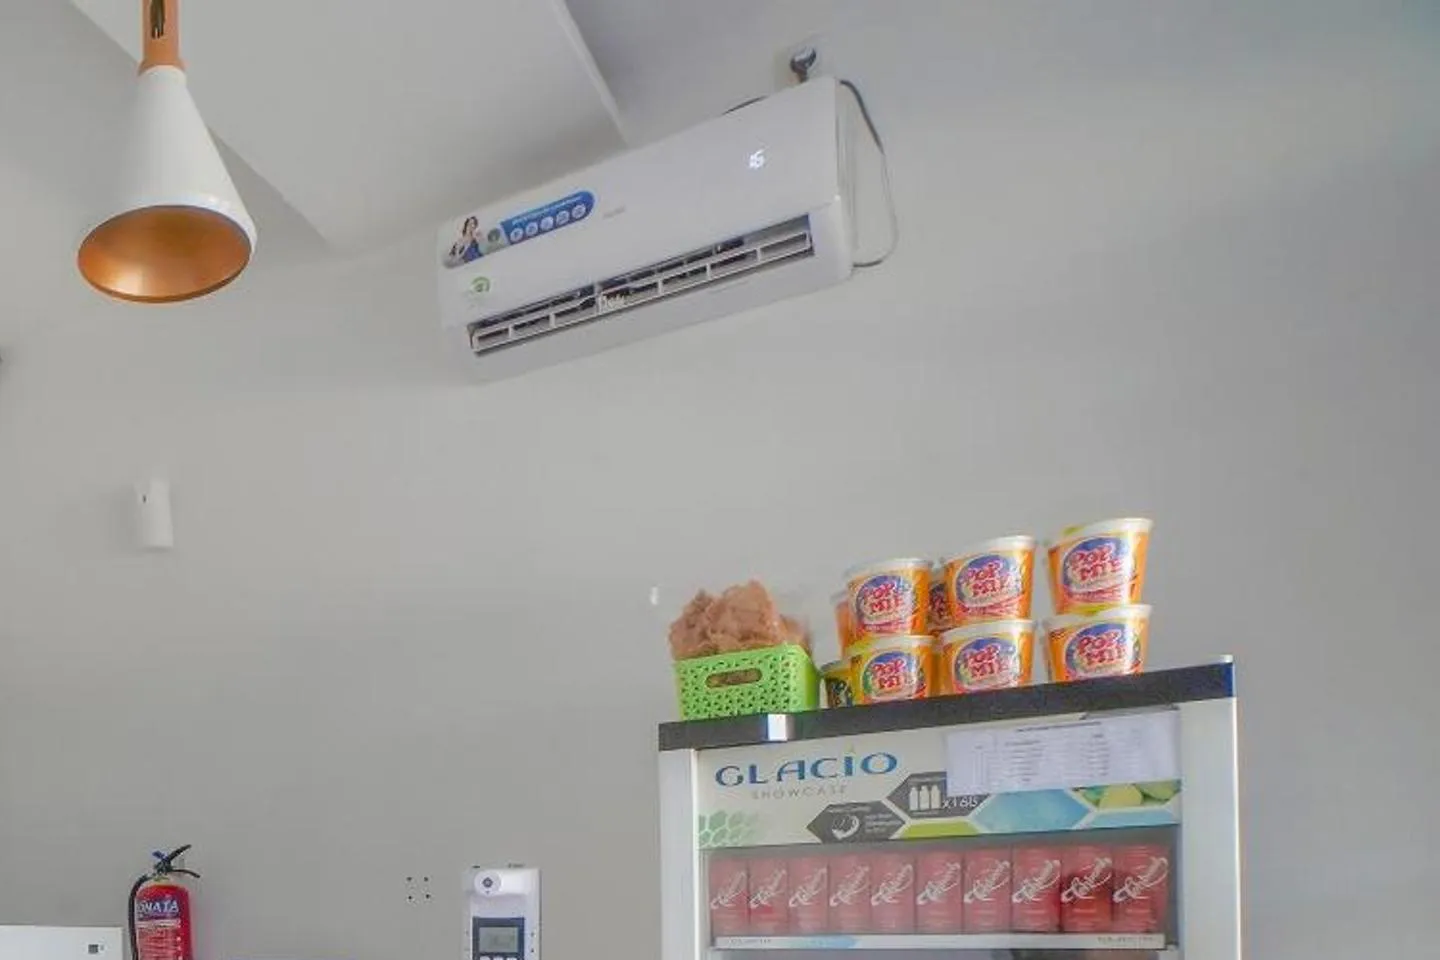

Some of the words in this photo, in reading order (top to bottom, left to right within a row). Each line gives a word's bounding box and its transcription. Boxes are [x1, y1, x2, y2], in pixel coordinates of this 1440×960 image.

[1071, 544, 1114, 569] POP
[967, 561, 1002, 581] POP
[1076, 629, 1122, 654] POP
[964, 643, 1000, 665] POP
[871, 658, 906, 677] POP
[715, 751, 899, 788] GLACIO
[750, 784, 849, 801] SHOWCASE
